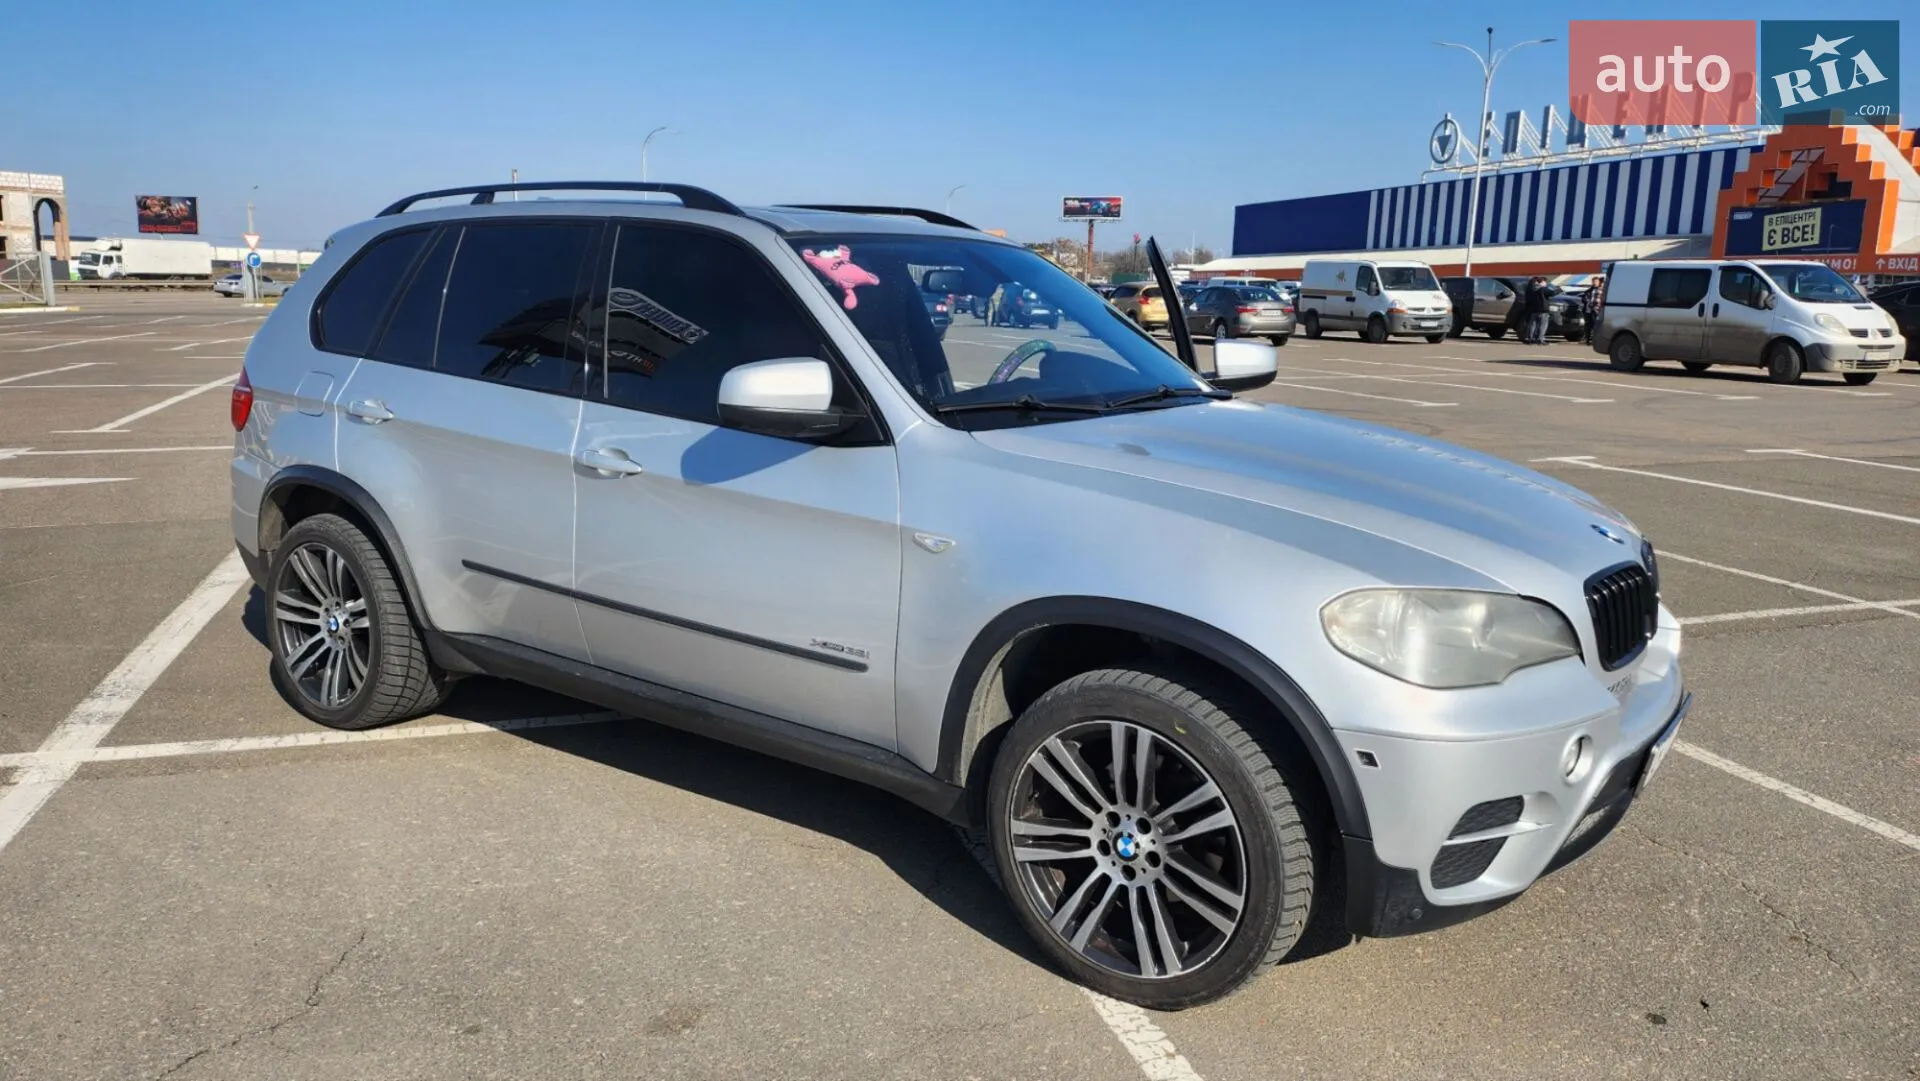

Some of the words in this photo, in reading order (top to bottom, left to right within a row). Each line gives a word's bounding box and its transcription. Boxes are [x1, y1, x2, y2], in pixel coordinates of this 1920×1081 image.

[1767, 217, 1774, 227] В
[1775, 211, 1816, 226] ЕПІЦЕНТРІ
[1767, 229, 1777, 246] Є
[1780, 224, 1816, 245] ВСЕ!
[1887, 258, 1919, 270] ВХІД
